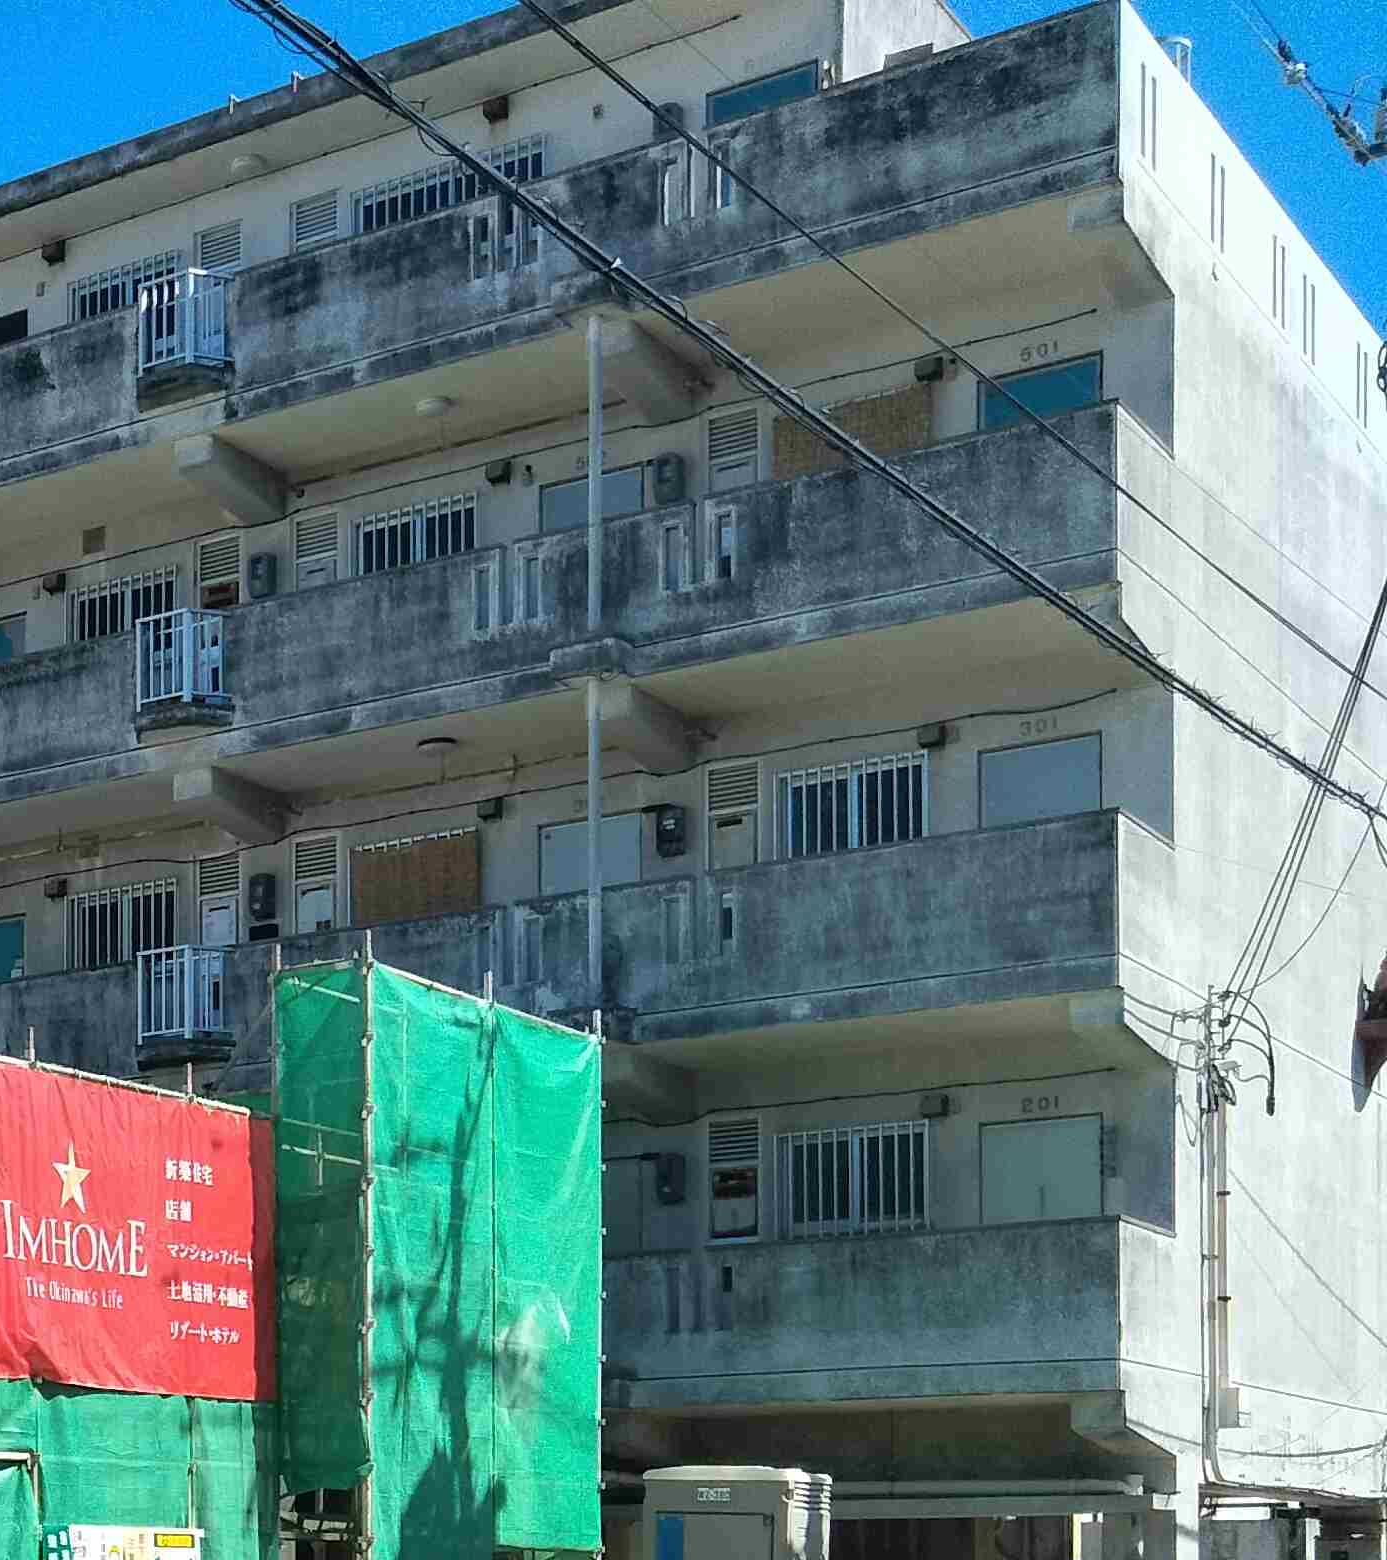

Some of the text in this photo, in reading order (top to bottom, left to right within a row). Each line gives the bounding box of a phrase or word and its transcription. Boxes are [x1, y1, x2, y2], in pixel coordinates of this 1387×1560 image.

[1019, 340, 1059, 362] 501
[1018, 713, 1058, 737] 301
[1020, 1095, 1060, 1113] 201
[0, 1199, 149, 1277] IMHOME
[25, 1276, 47, 1299] The
[101, 1288, 125, 1310] Life
